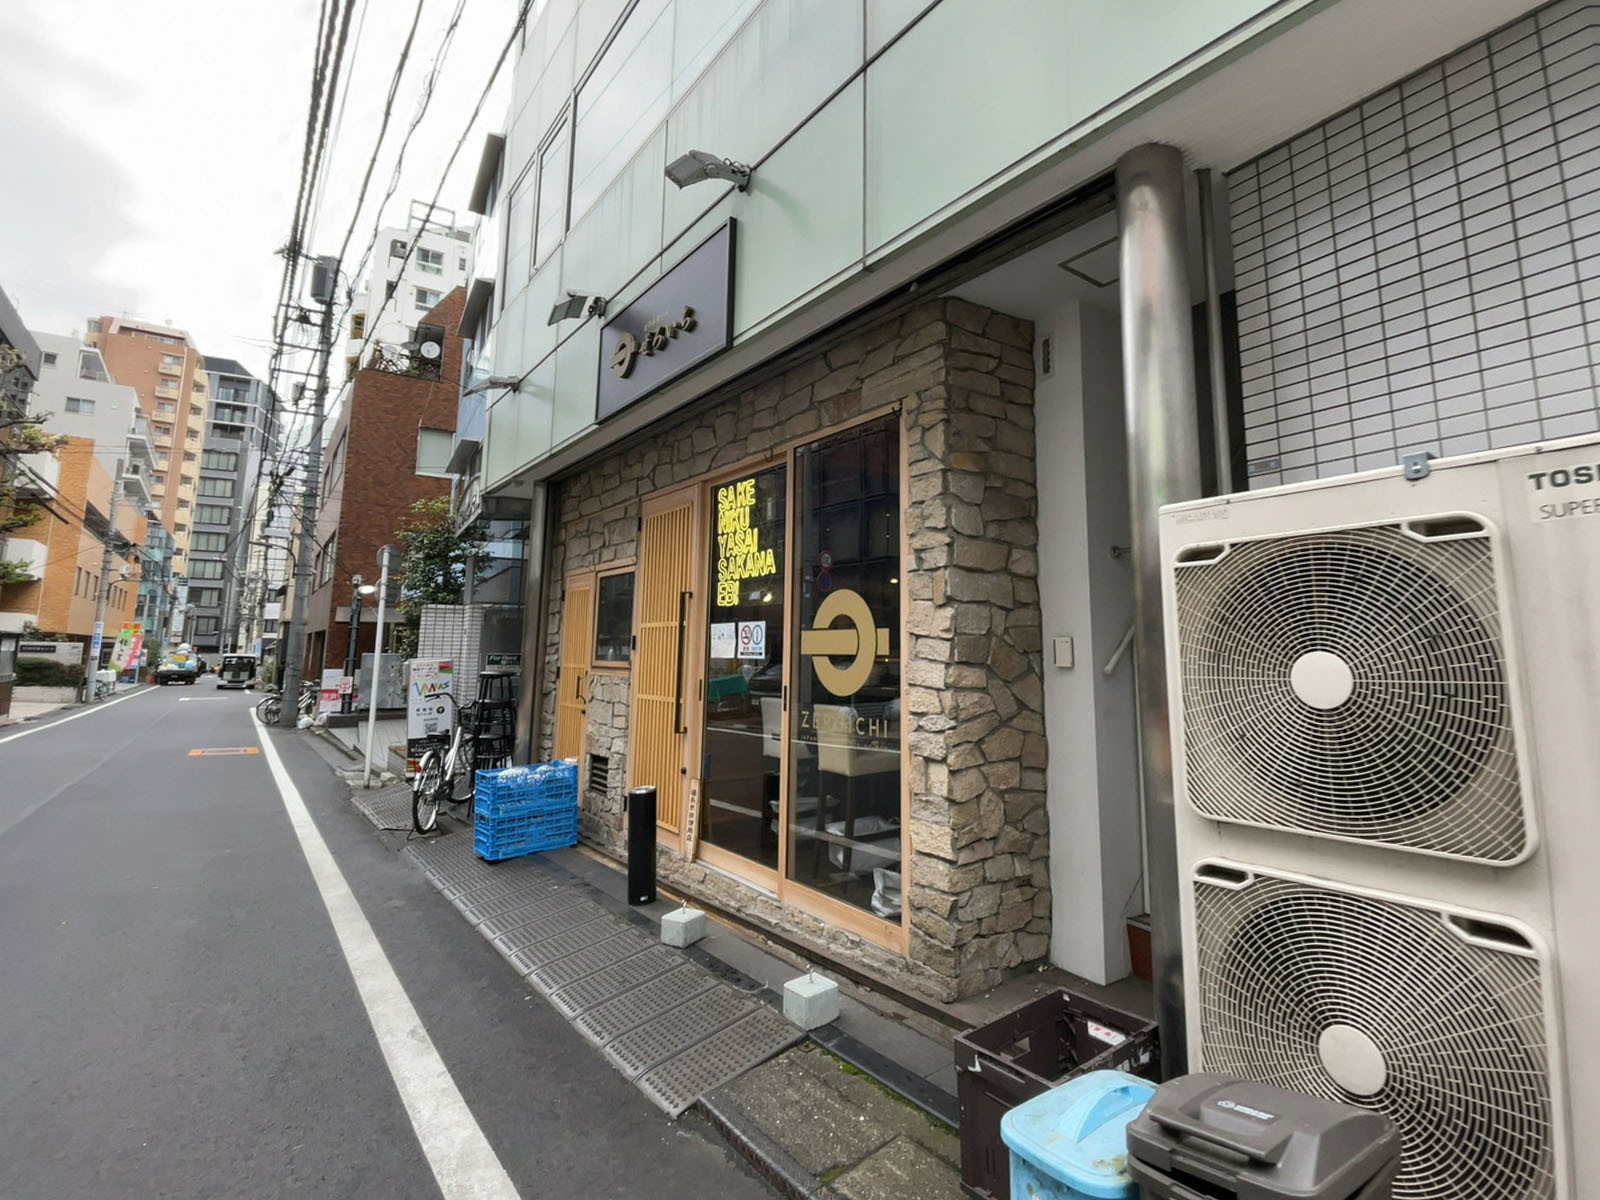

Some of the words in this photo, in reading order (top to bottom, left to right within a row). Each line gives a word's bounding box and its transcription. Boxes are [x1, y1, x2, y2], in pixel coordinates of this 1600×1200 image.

[1528, 464, 1600, 490] TOS
[718, 479, 756, 511] SAKE
[718, 506, 750, 534] NIKU
[718, 527, 758, 559] YASAI
[718, 548, 776, 581] SAKANA
